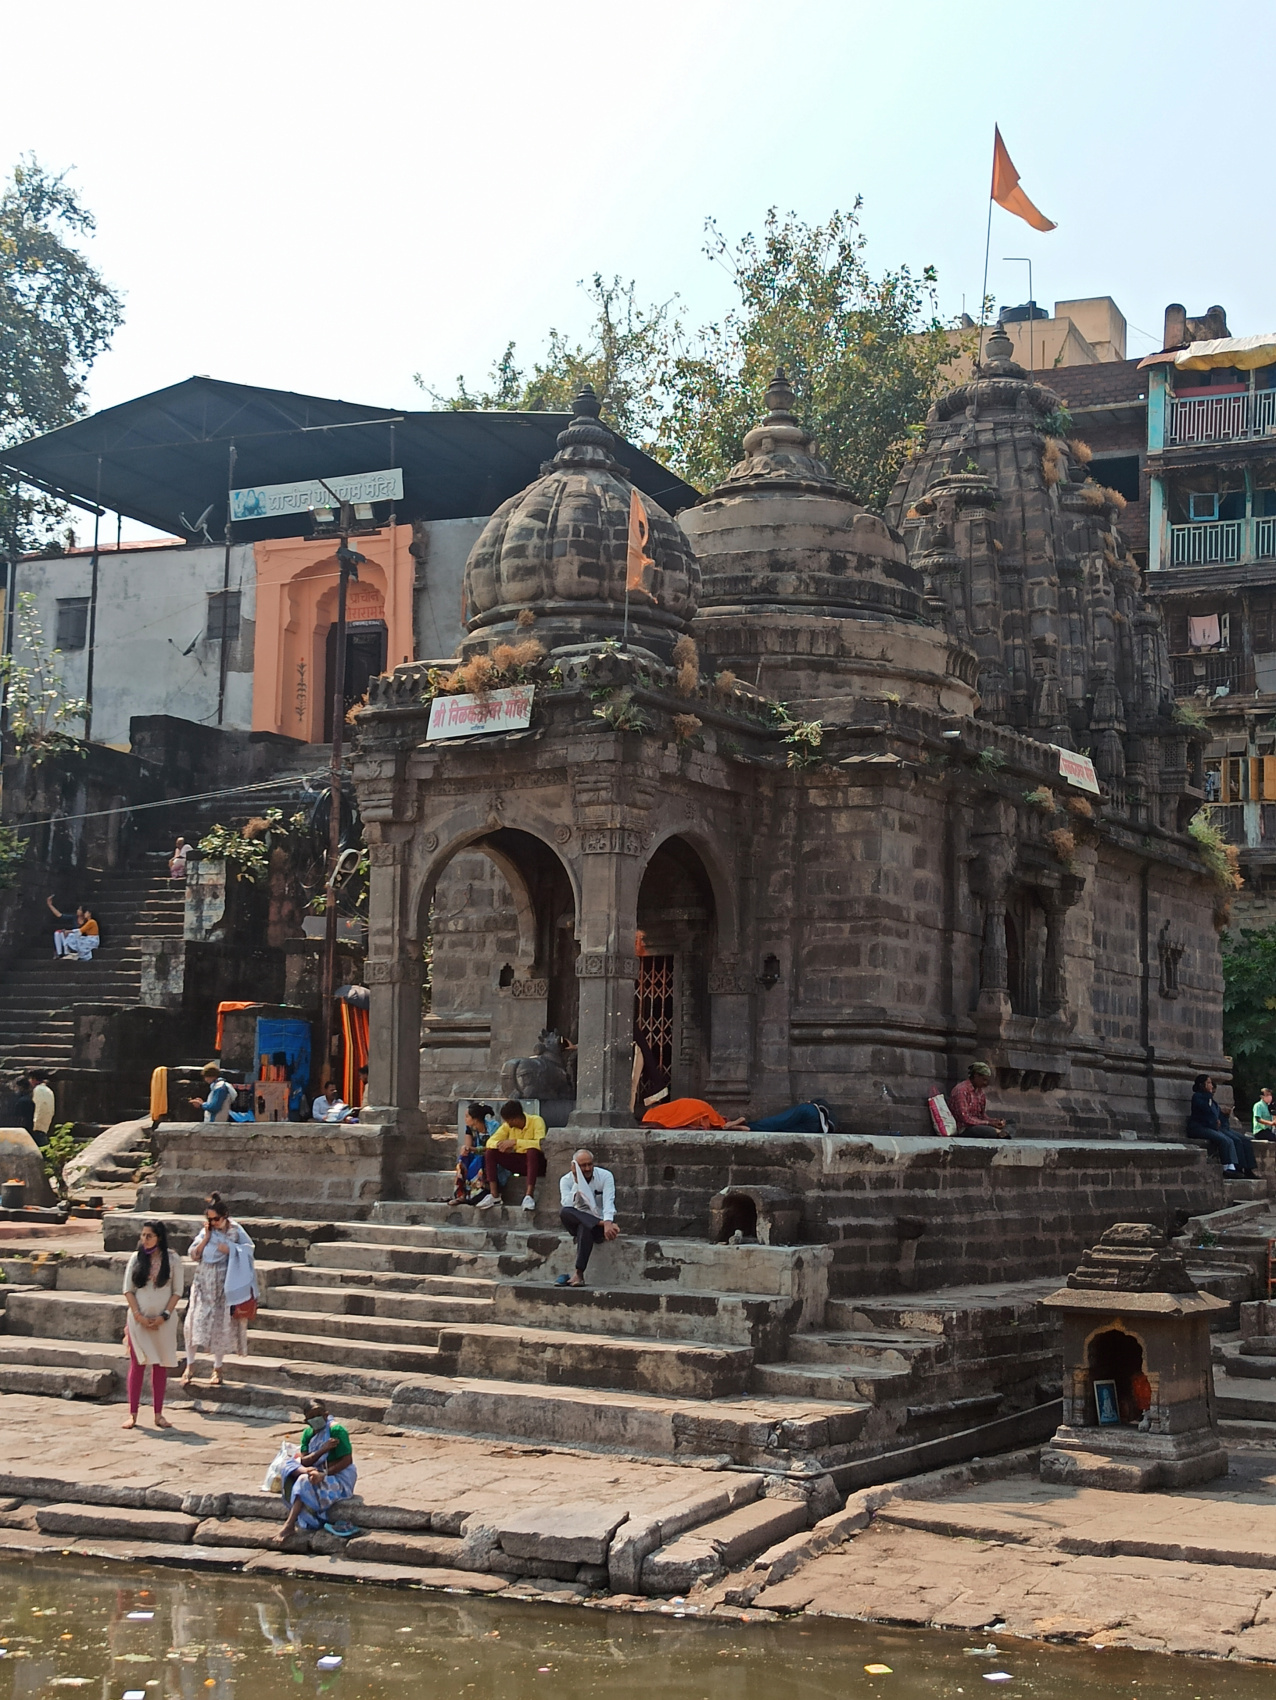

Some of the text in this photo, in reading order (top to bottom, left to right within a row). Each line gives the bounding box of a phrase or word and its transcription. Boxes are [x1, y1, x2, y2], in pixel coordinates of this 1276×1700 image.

[268, 486, 313, 511] प्राचीन
[364, 475, 397, 498] मंदिर
[433, 702, 447, 728] श्री
